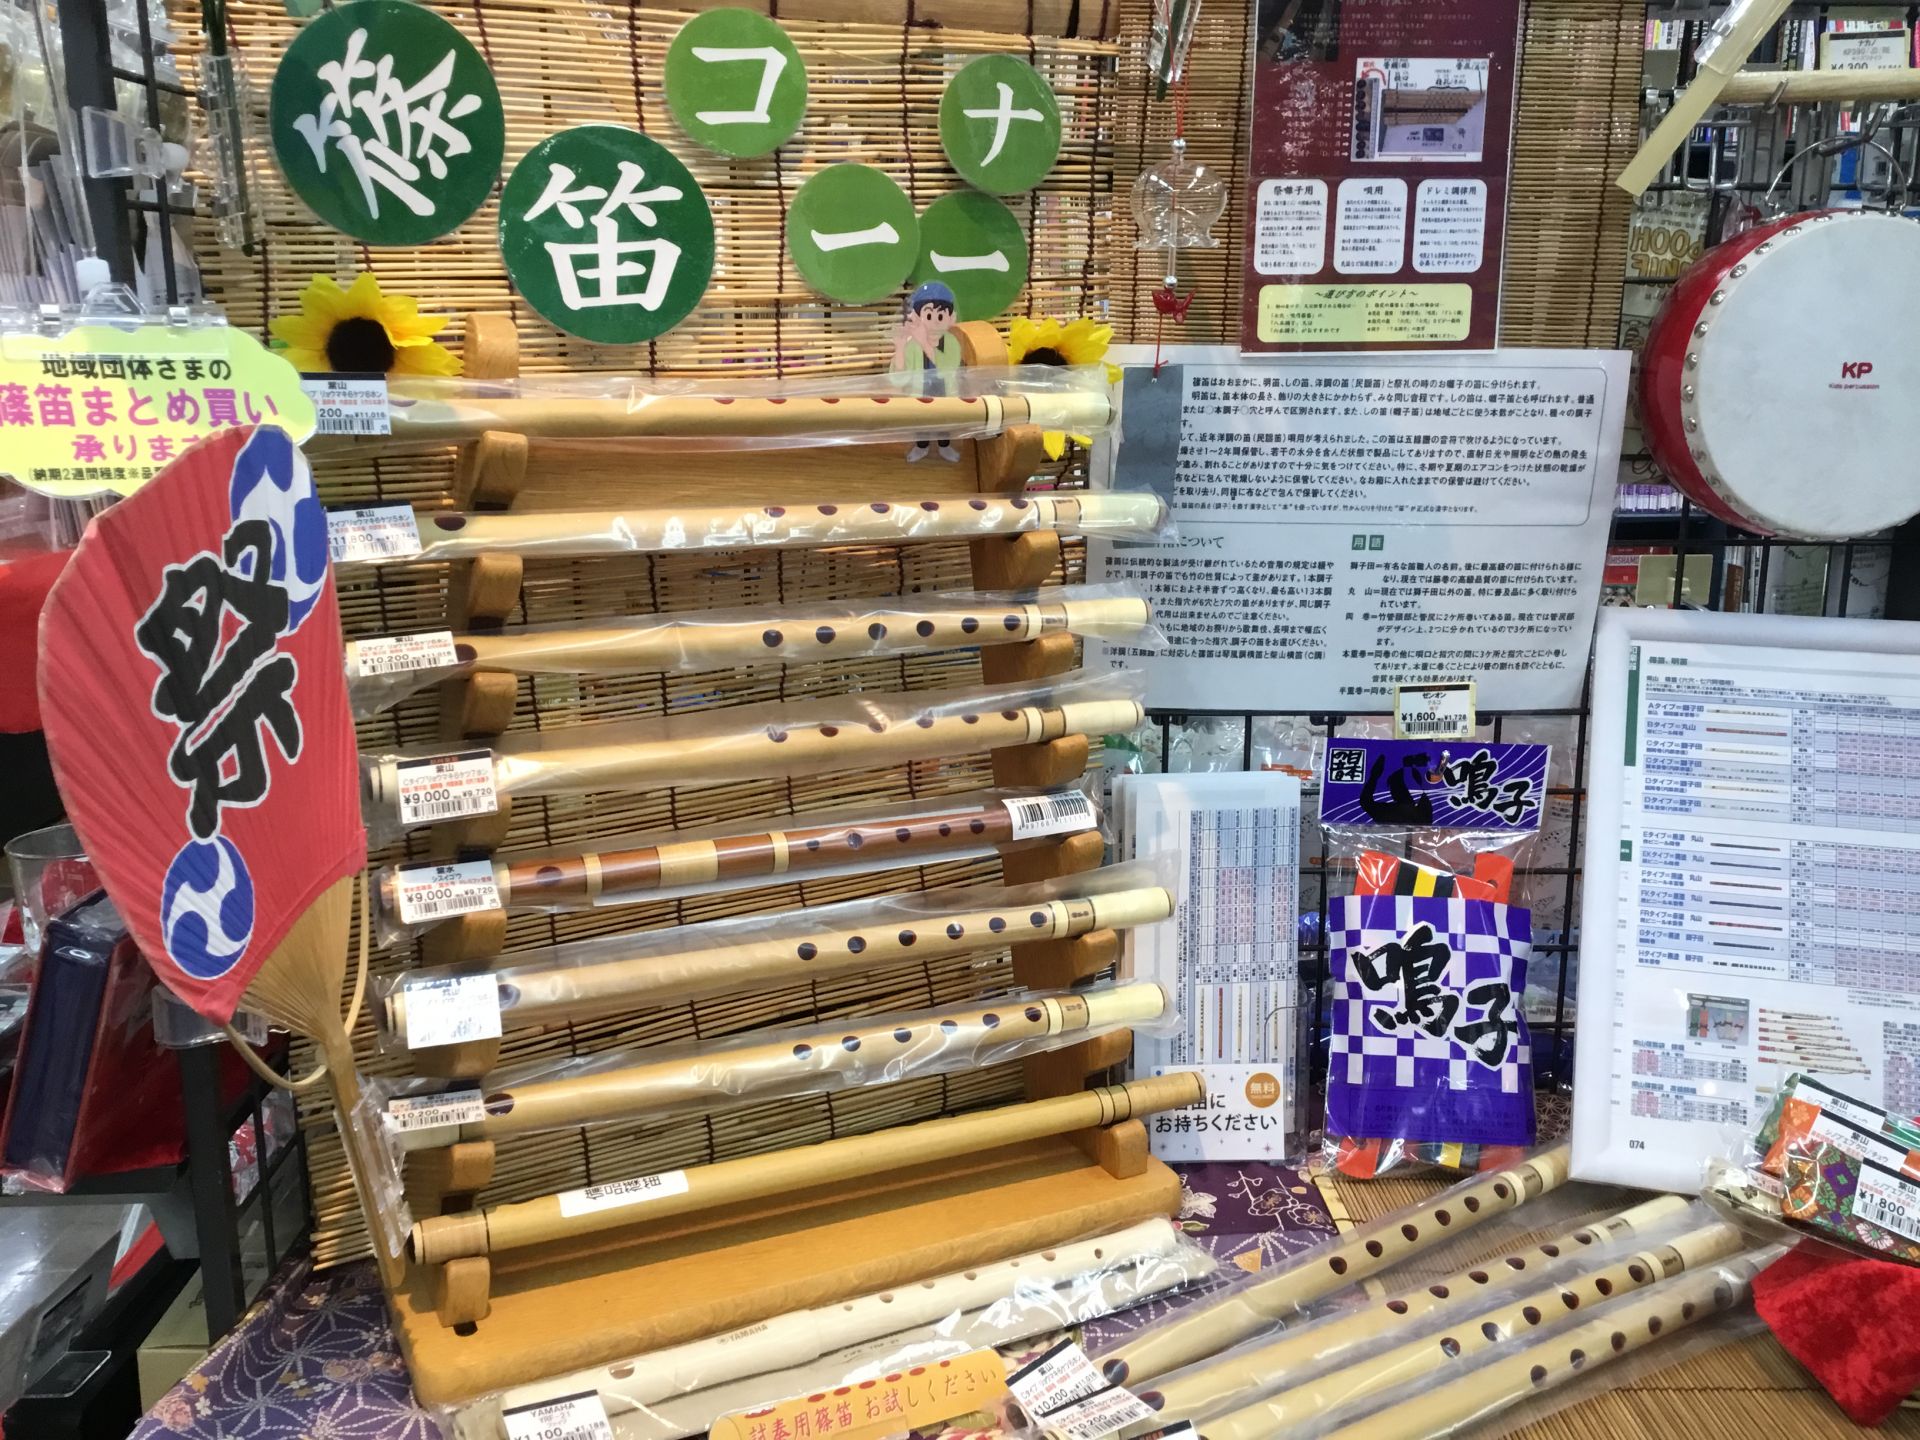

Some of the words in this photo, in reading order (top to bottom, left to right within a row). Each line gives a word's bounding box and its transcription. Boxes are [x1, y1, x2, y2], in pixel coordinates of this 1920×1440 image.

[42, 353, 232, 381] 地域団体さまの
[1842, 361, 1873, 379] KP
[0, 382, 279, 428] 篠笛まとめ買い
[136, 520, 300, 839] 祭
[1401, 712, 1436, 721] ¥1,600
[404, 789, 450, 805] ¥9,000
[1443, 750, 1536, 824] 鳴子
[406, 888, 452, 903] ¥9,000
[1351, 925, 1518, 1068] 鳴子
[1155, 1113, 1277, 1133] お持ちください
[1629, 1140, 1645, 1150] 074
[1859, 1189, 1905, 1216] ¥1,800
[730, 1324, 768, 1341] YAMAHA
[531, 1402, 576, 1418] YAMAHA
[749, 1401, 853, 1440] 試奏用篠笛
[866, 1368, 997, 1420] お試しください
